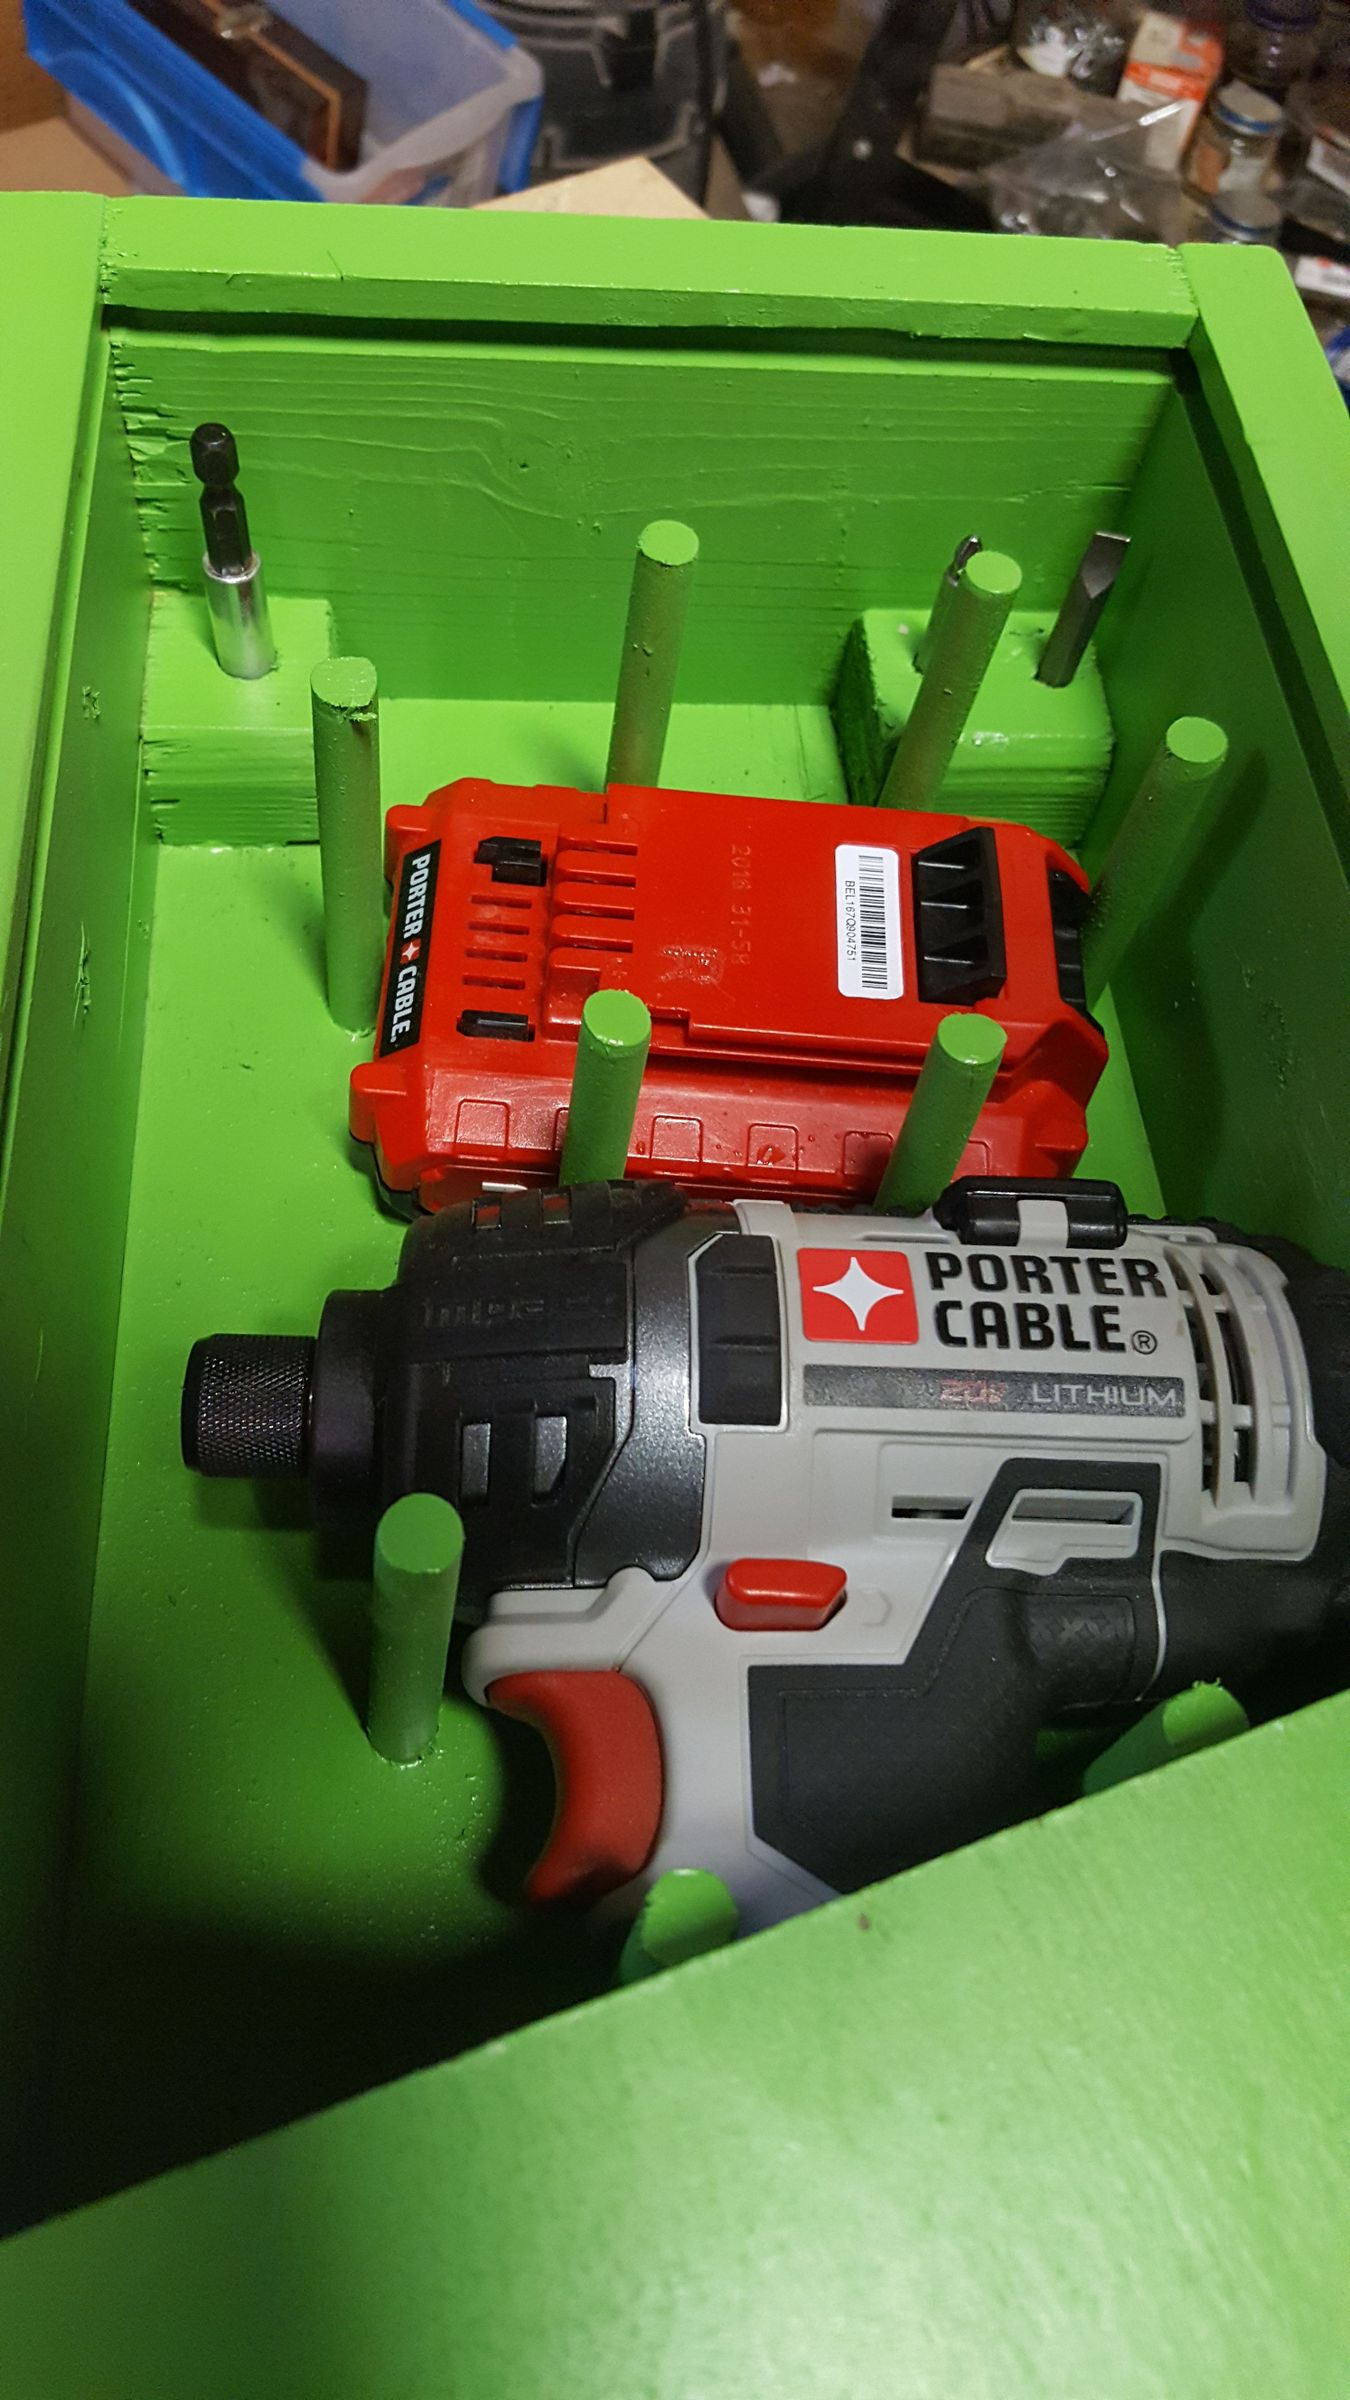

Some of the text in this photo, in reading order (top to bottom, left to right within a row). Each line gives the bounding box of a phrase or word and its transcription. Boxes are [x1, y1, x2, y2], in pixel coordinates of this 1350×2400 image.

[403, 853, 432, 939] PORTER
[844, 879, 858, 961] BEL167Q904751
[925, 1252, 1168, 1298] PORTER
[1031, 1383, 1177, 1408] LITHIUM
